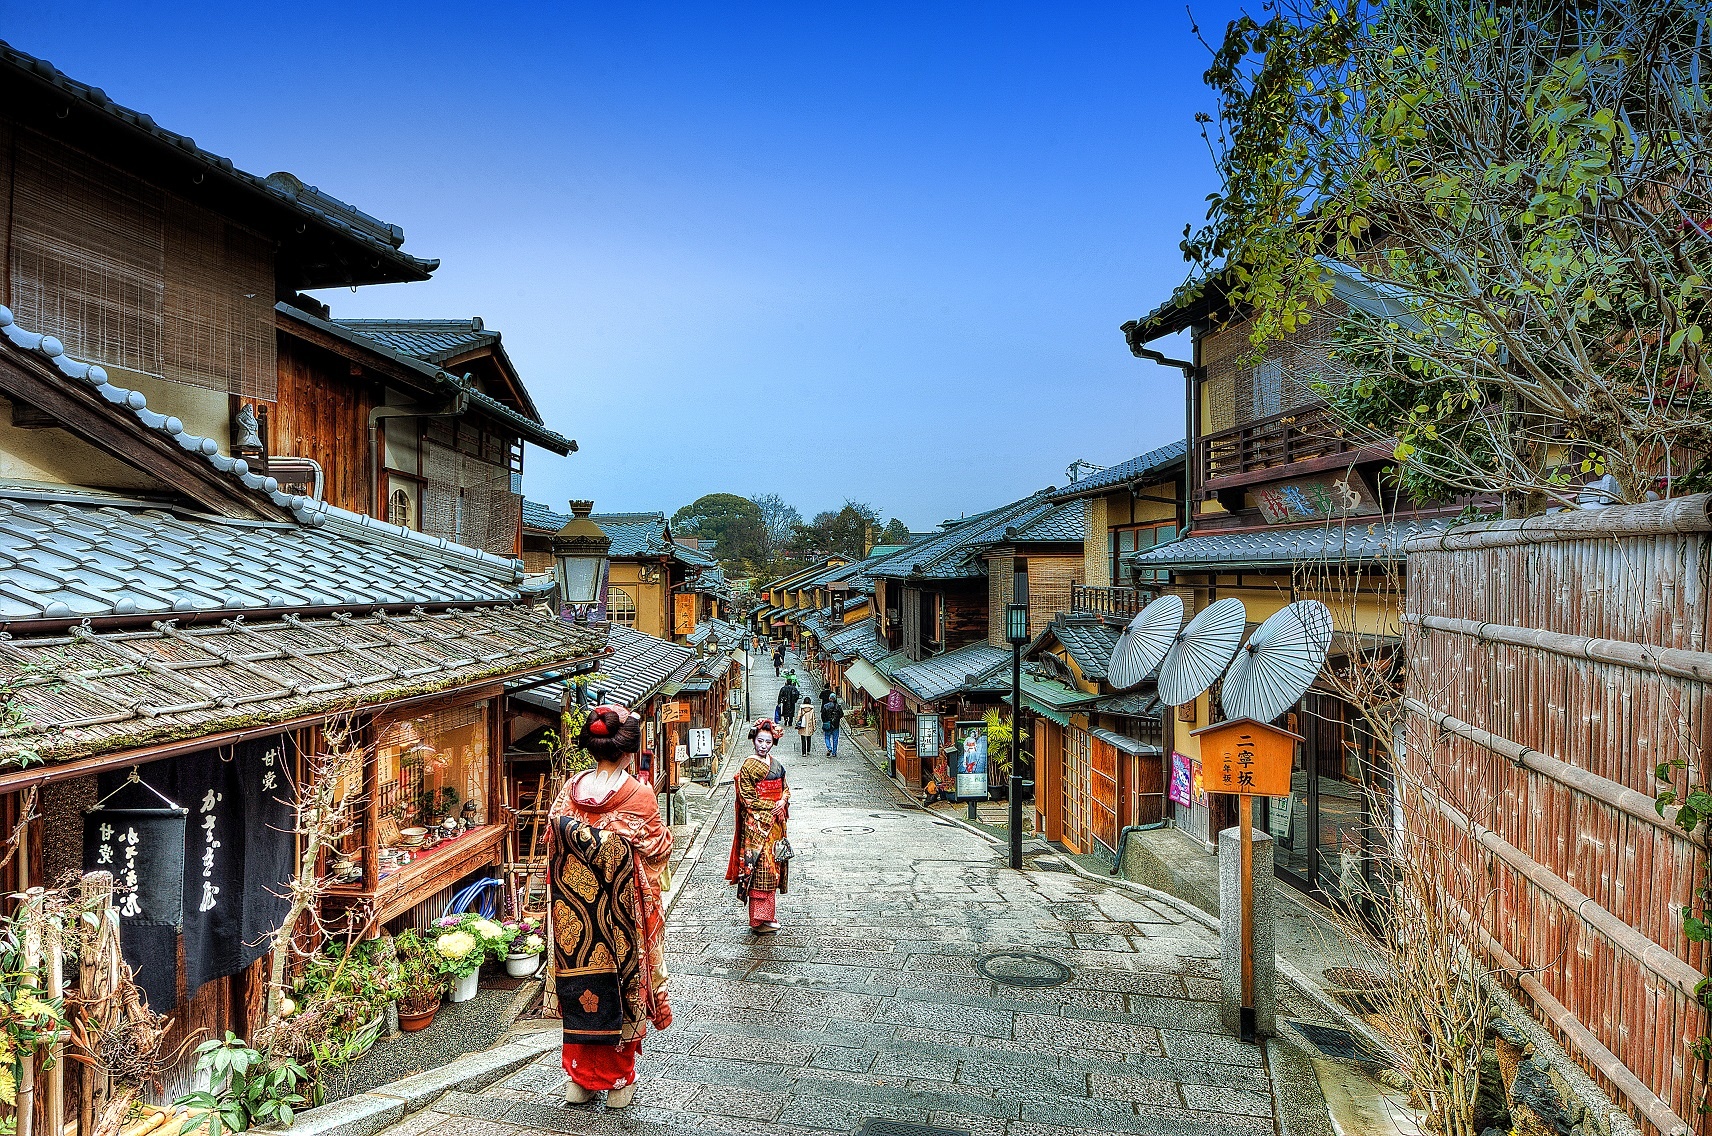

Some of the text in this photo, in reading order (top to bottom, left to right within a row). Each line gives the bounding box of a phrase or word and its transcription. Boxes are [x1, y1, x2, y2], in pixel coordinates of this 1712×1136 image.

[261, 748, 278, 792] 甘党
[1236, 734, 1256, 787] 二寧坂
